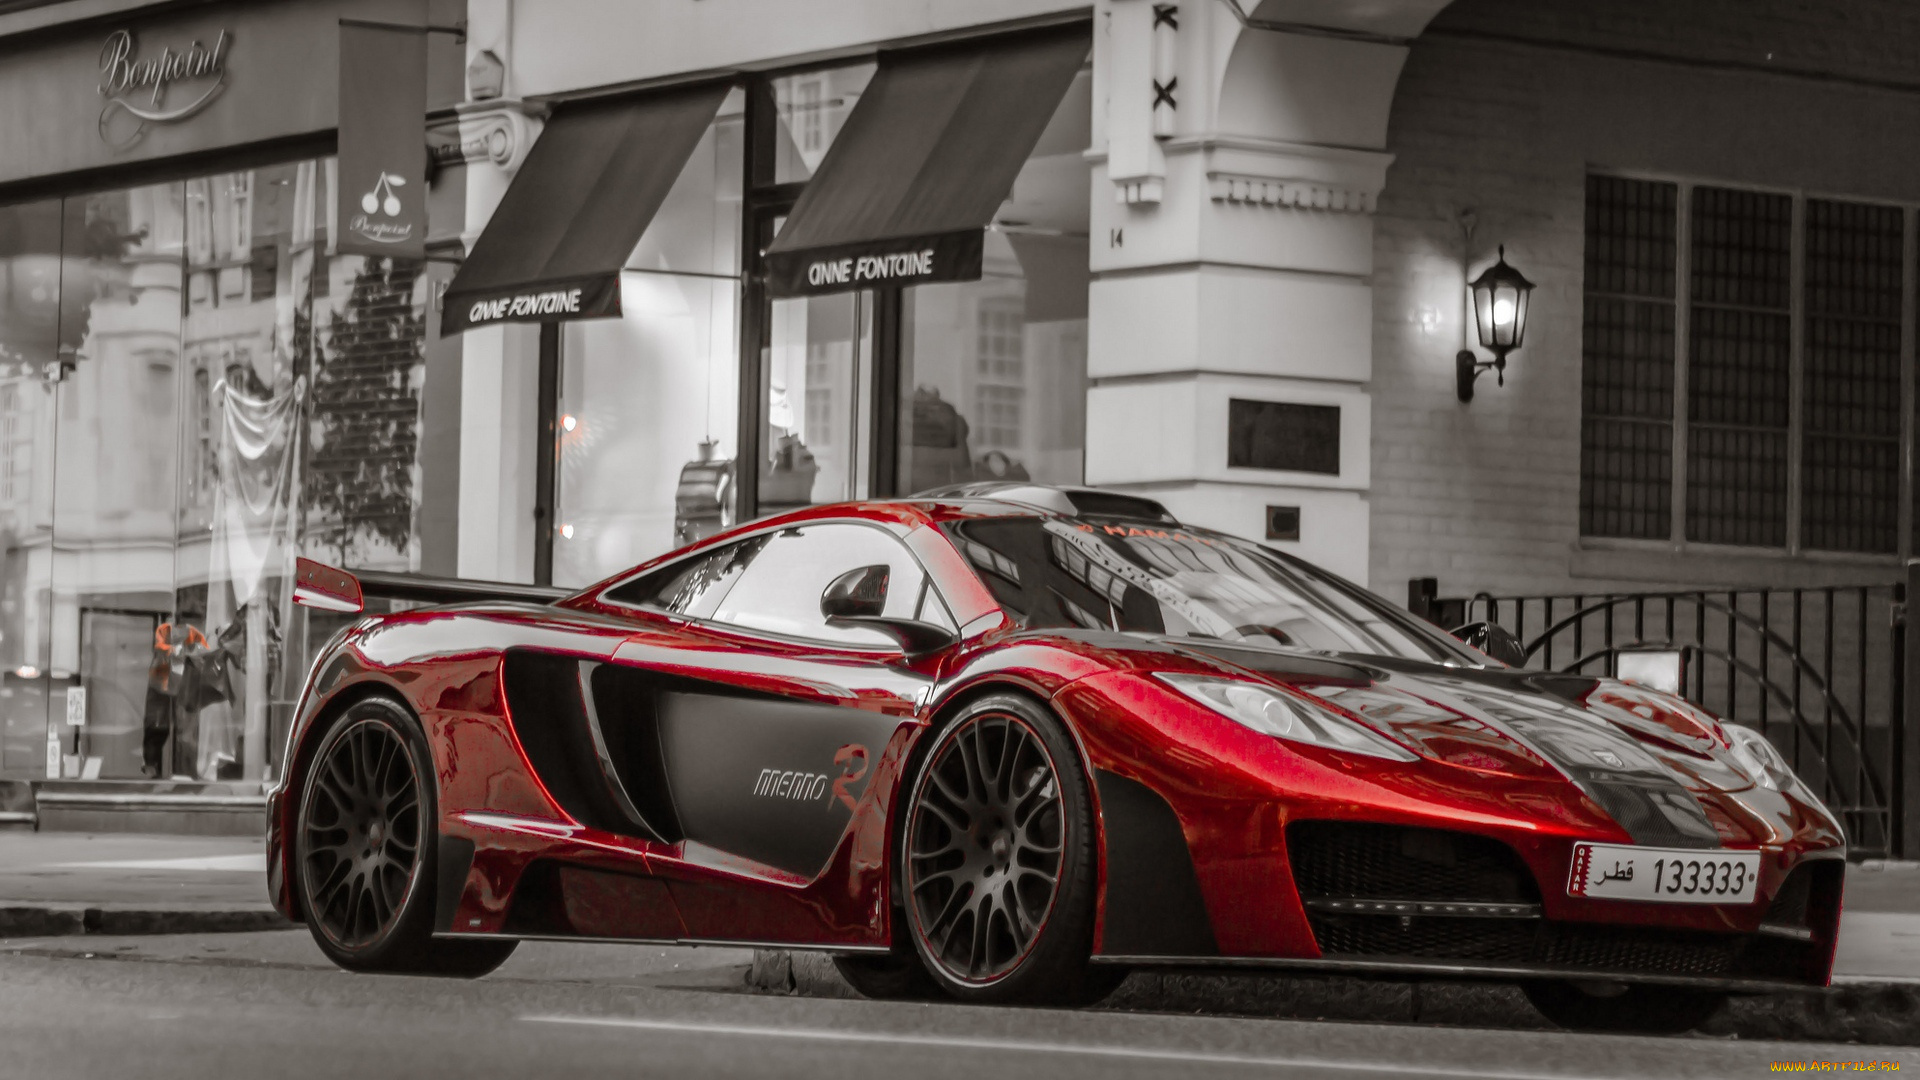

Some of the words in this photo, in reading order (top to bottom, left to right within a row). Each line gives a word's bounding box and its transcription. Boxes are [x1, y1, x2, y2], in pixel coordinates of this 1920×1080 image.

[97, 28, 225, 106] Bonpoint
[1110, 228, 1123, 248] 14
[1593, 859, 1634, 886] قطر
[1653, 857, 1747, 895] 133333
